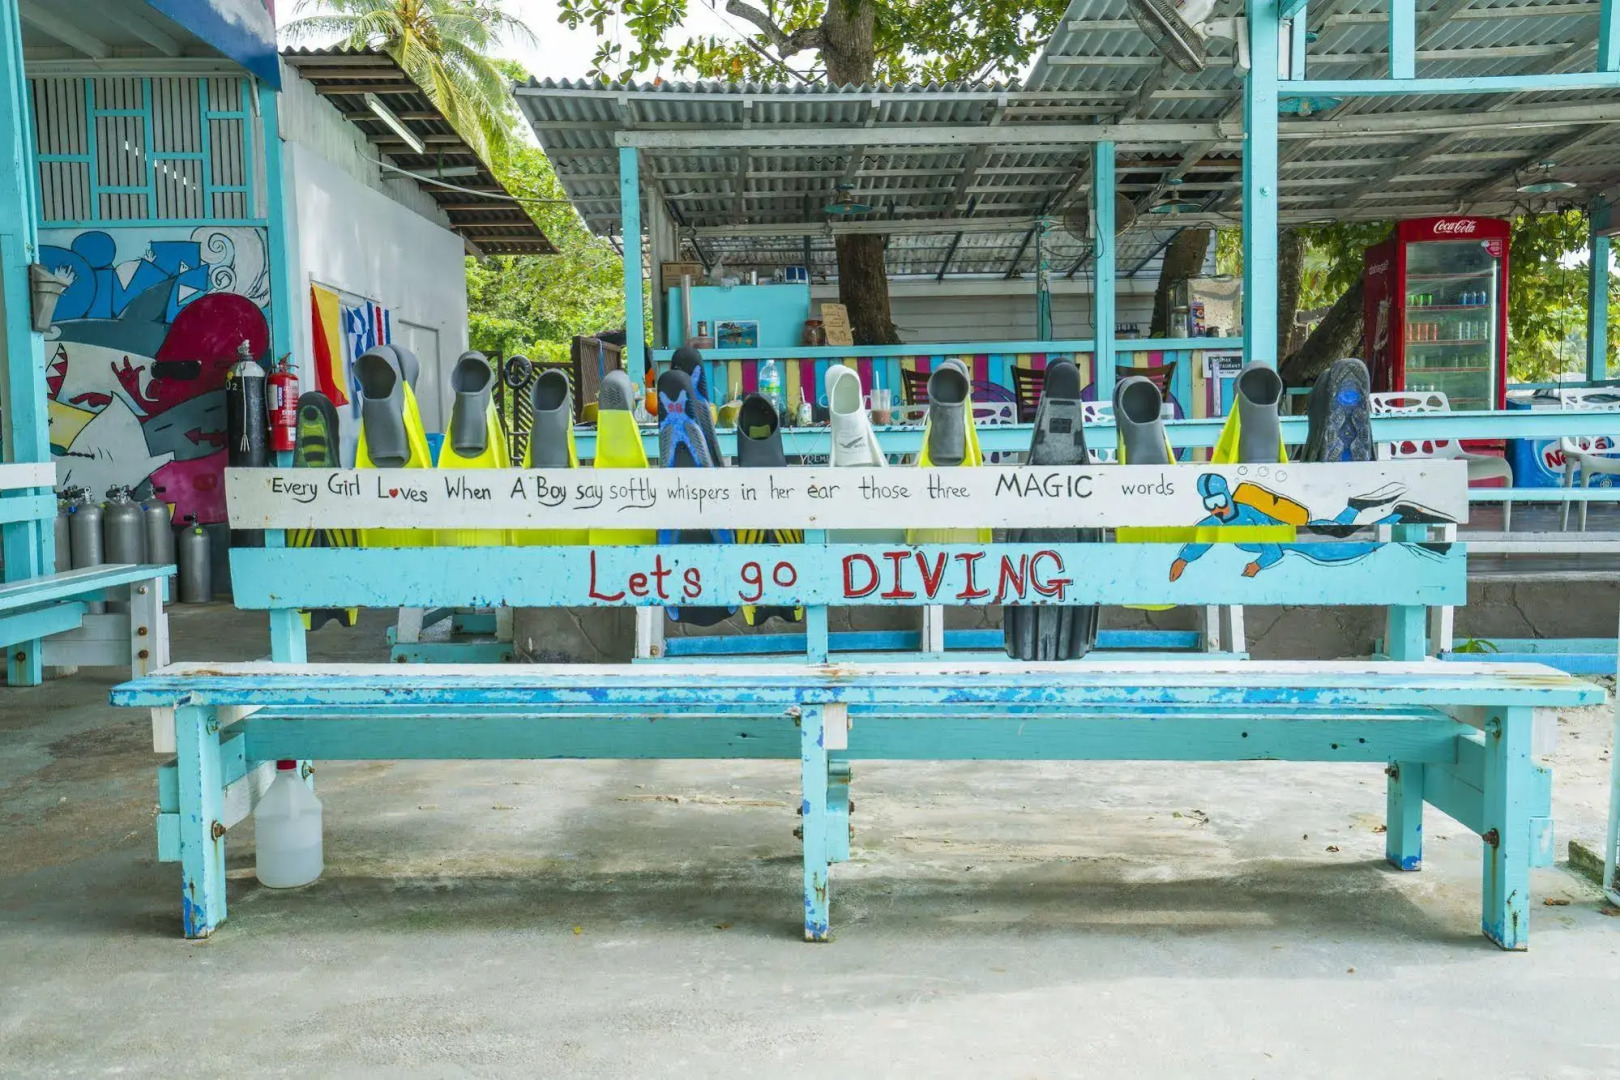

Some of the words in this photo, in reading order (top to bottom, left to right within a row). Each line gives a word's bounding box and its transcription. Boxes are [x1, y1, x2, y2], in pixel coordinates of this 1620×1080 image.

[272, 477, 318, 503] Every
[327, 473, 361, 496] Girl
[444, 475, 492, 500] When
[510, 476, 527, 500] A
[536, 475, 567, 507] Boy
[573, 484, 603, 510] say
[609, 477, 657, 512] softly
[667, 476, 730, 514] whispers
[741, 483, 757, 500] in
[769, 475, 795, 500] her
[807, 484, 840, 499] ear
[858, 475, 910, 500] those
[926, 473, 971, 499] three
[994, 472, 1093, 499] MAGIC
[1121, 472, 1175, 496] words
[589, 550, 702, 602] Let's
[738, 561, 798, 602] go
[842, 550, 1074, 602] DIVING
